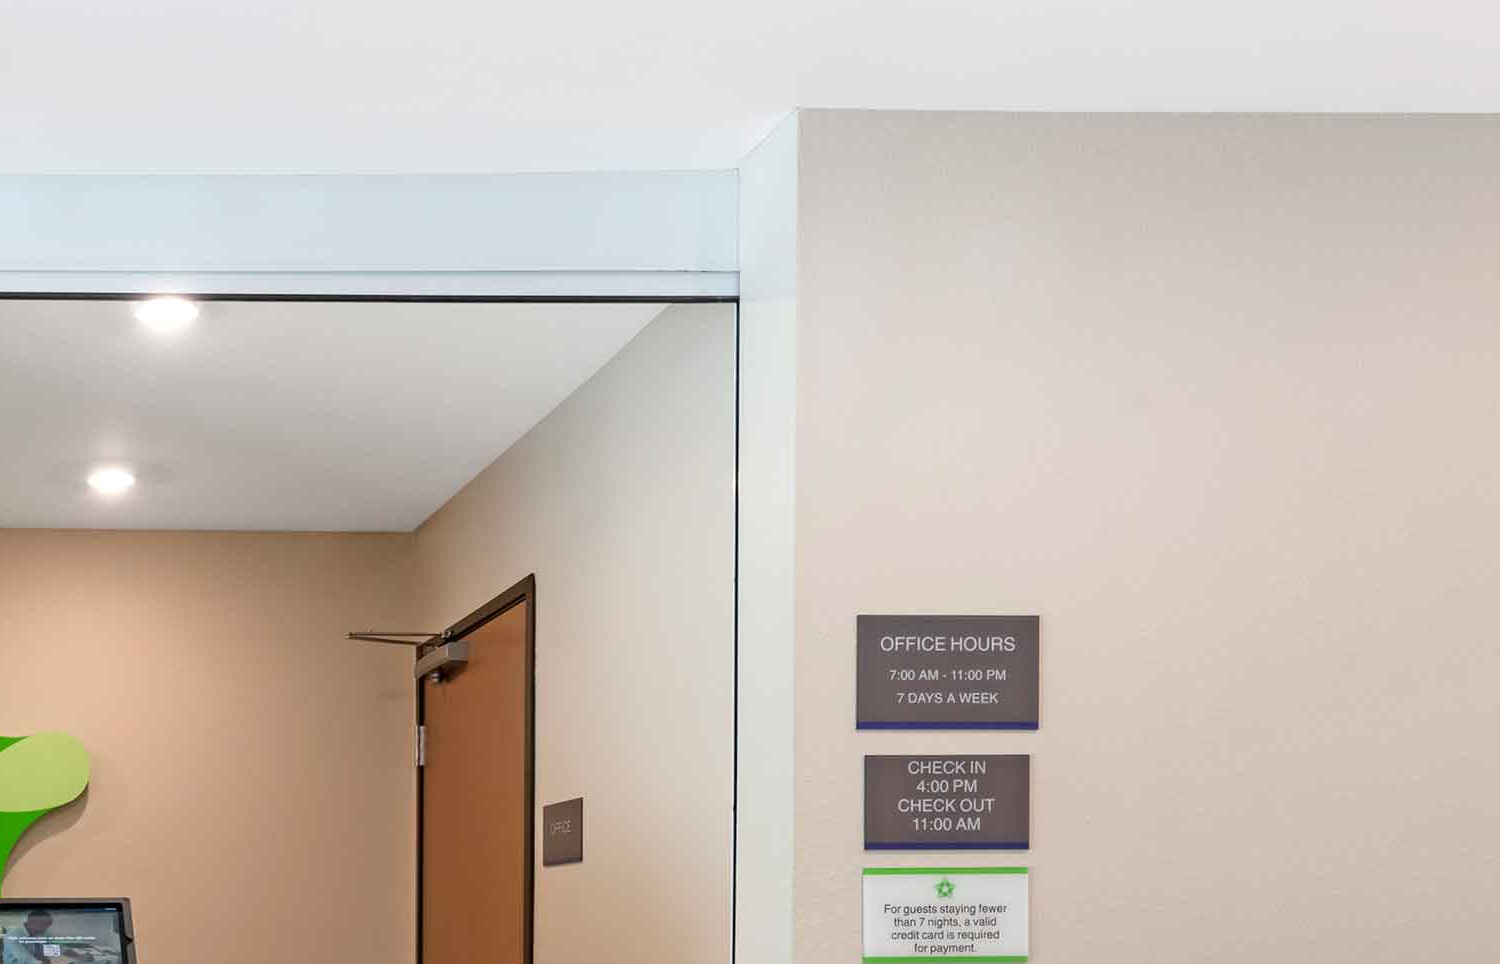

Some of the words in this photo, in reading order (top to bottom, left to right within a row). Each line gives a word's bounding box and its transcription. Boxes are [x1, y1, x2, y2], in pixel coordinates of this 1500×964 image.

[880, 636, 946, 652] OFFICE
[951, 636, 1016, 652] HOURS
[890, 669, 915, 681] 7:00
[918, 669, 939, 681] AM
[951, 669, 983, 681] 11:00
[986, 669, 1006, 681] PM
[897, 692, 904, 704] 7
[908, 692, 943, 704] DAYS
[947, 692, 956, 704] A
[959, 692, 999, 704] WEEK
[908, 760, 966, 775] CHECK
[970, 760, 987, 775] IN
[916, 779, 948, 793] 4:00
[953, 779, 978, 793] PM
[898, 798, 957, 813] CHECK
[960, 798, 995, 813] OUT
[913, 817, 952, 831] 11:00
[956, 817, 981, 831] AM
[884, 904, 901, 914] For
[903, 906, 937, 917] guests
[939, 905, 976, 916] staying
[978, 904, 1007, 914] fewer
[894, 917, 916, 927] than
[919, 917, 926, 927] 7
[927, 917, 962, 930] nights,
[964, 919, 971, 927] a
[972, 917, 997, 927] valid
[891, 930, 920, 940] credit
[922, 930, 945, 940] card
[947, 931, 955, 940] is
[957, 930, 1000, 942] required
[914, 943, 928, 953] for
[930, 944, 977, 955] payment.
